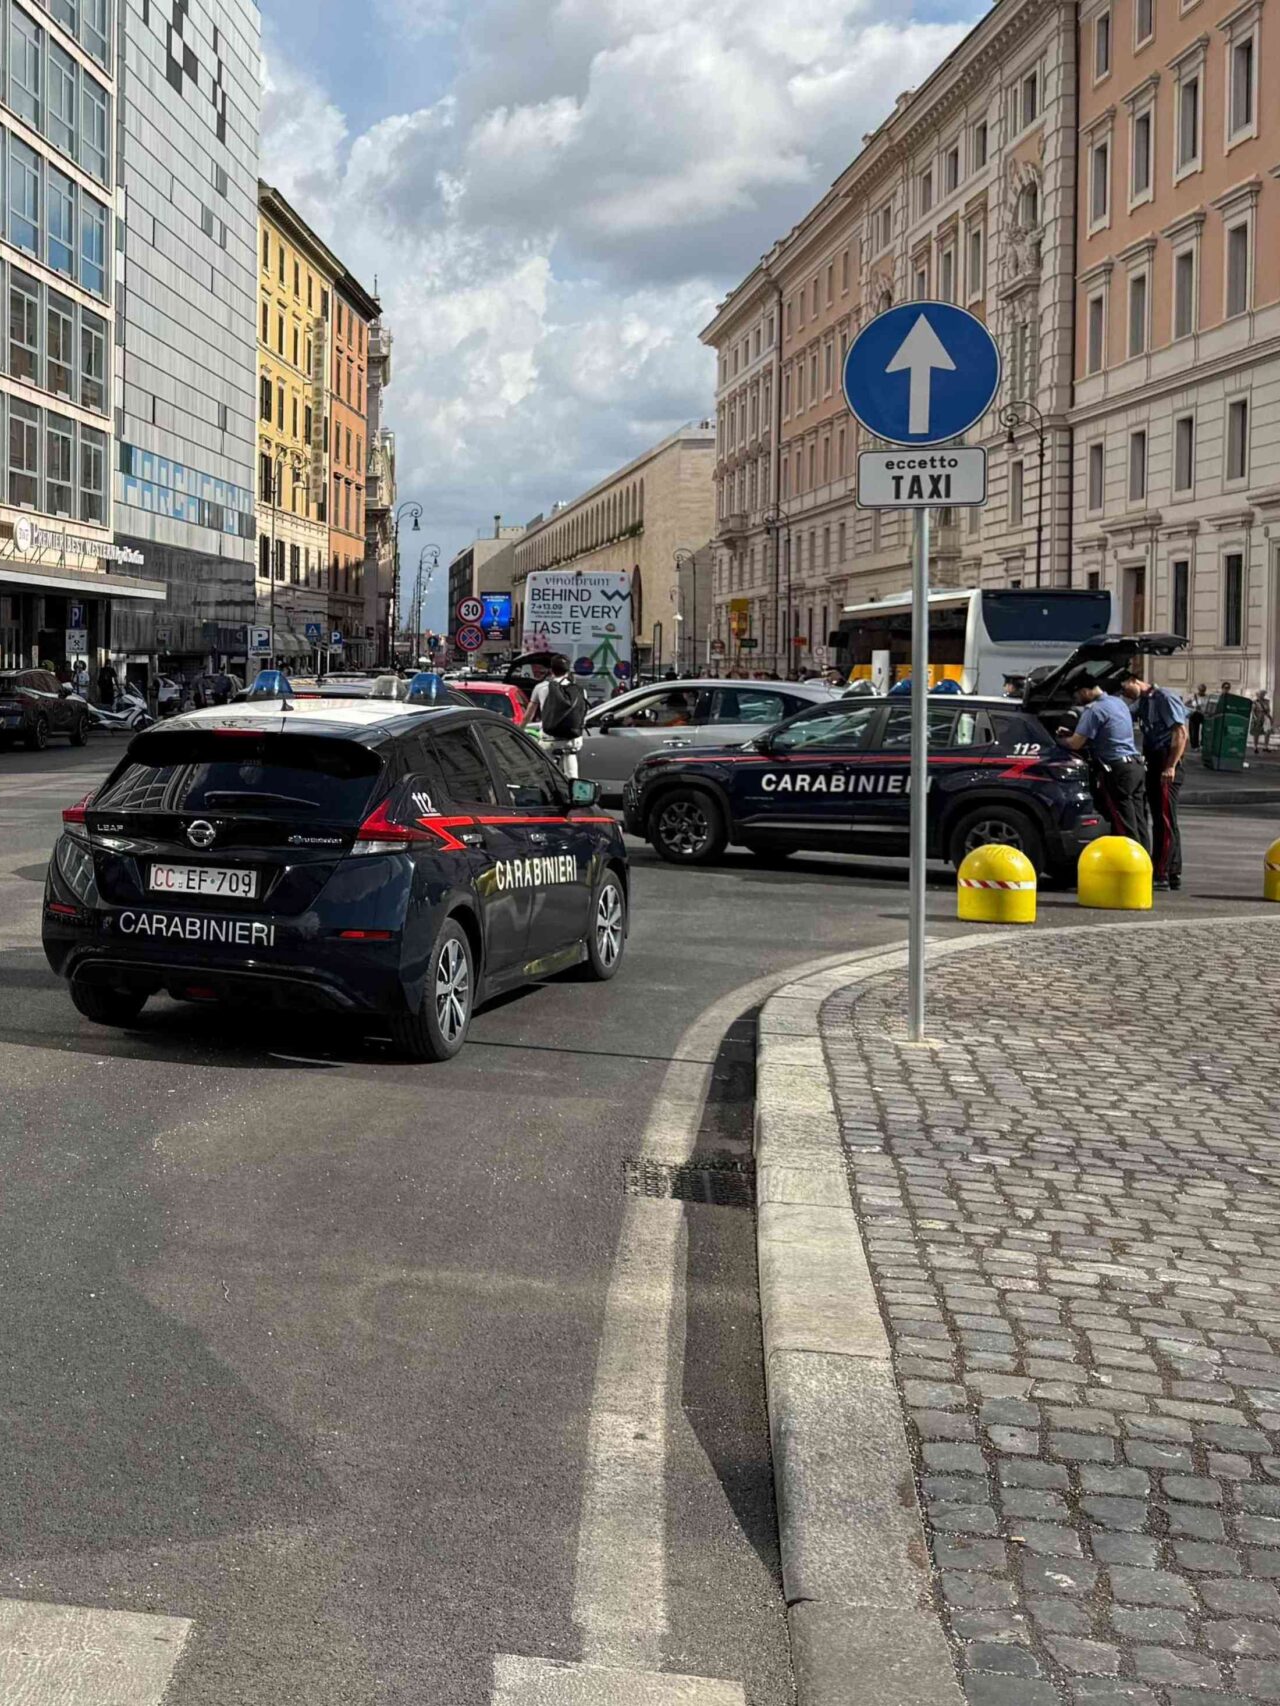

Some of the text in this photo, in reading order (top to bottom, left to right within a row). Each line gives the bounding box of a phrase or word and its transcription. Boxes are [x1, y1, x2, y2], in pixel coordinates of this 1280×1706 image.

[885, 456, 959, 470] eccetto
[891, 474, 951, 500] TAXI
[531, 588, 592, 602] BEHIND
[72, 607, 80, 627] P
[463, 604, 479, 617] 30
[570, 605, 622, 619] EVERY
[531, 620, 582, 635] TASTE
[251, 630, 269, 647] P
[331, 632, 341, 643] P
[1013, 743, 1041, 755] 112
[411, 792, 437, 814] 112
[495, 854, 578, 891] CARABINIERI
[154, 867, 252, 895] CC EF 709
[120, 912, 275, 947] CARABINIERI
